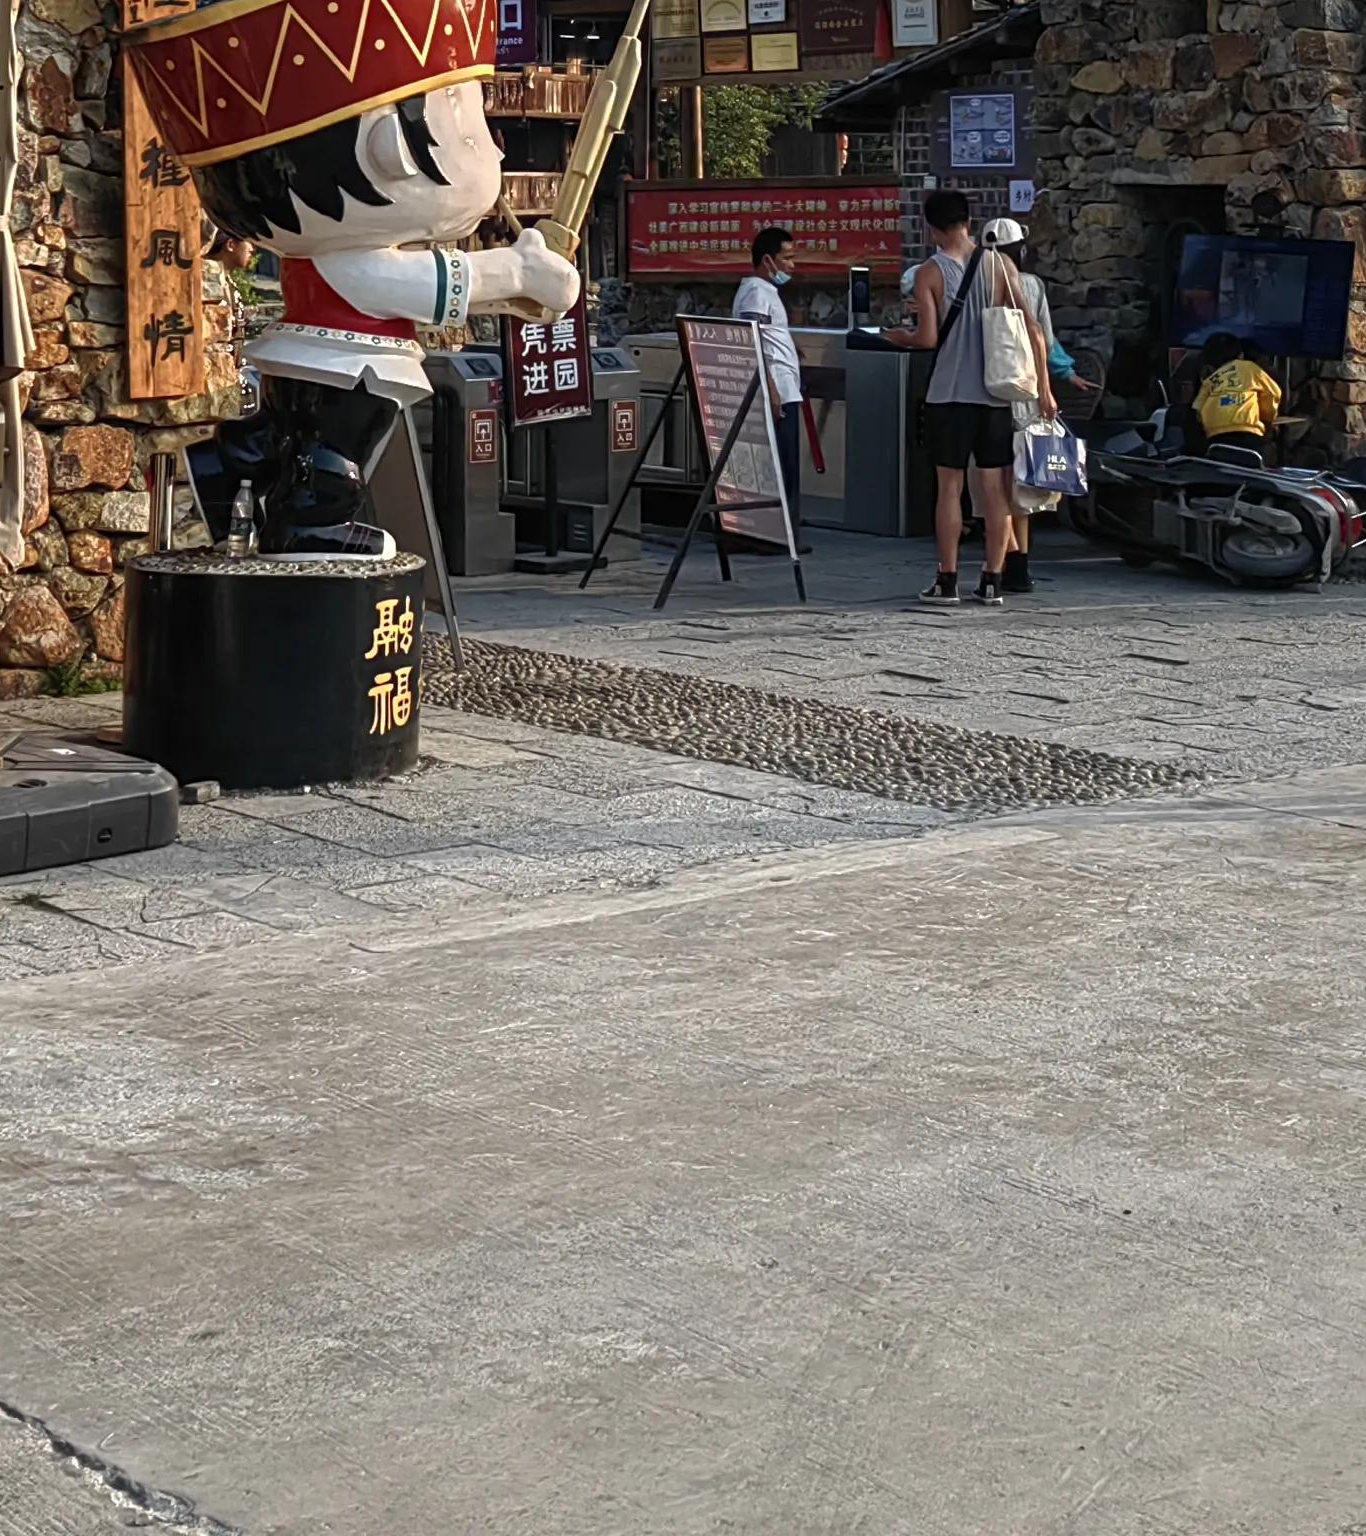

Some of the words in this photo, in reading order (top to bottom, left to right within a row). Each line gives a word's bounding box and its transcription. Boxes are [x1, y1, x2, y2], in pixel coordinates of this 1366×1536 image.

[520, 318, 577, 357] 凭票
[522, 358, 579, 396] 进园
[475, 443, 492, 453] 入口
[617, 432, 632, 442] 入口
[364, 595, 415, 735] 融福
